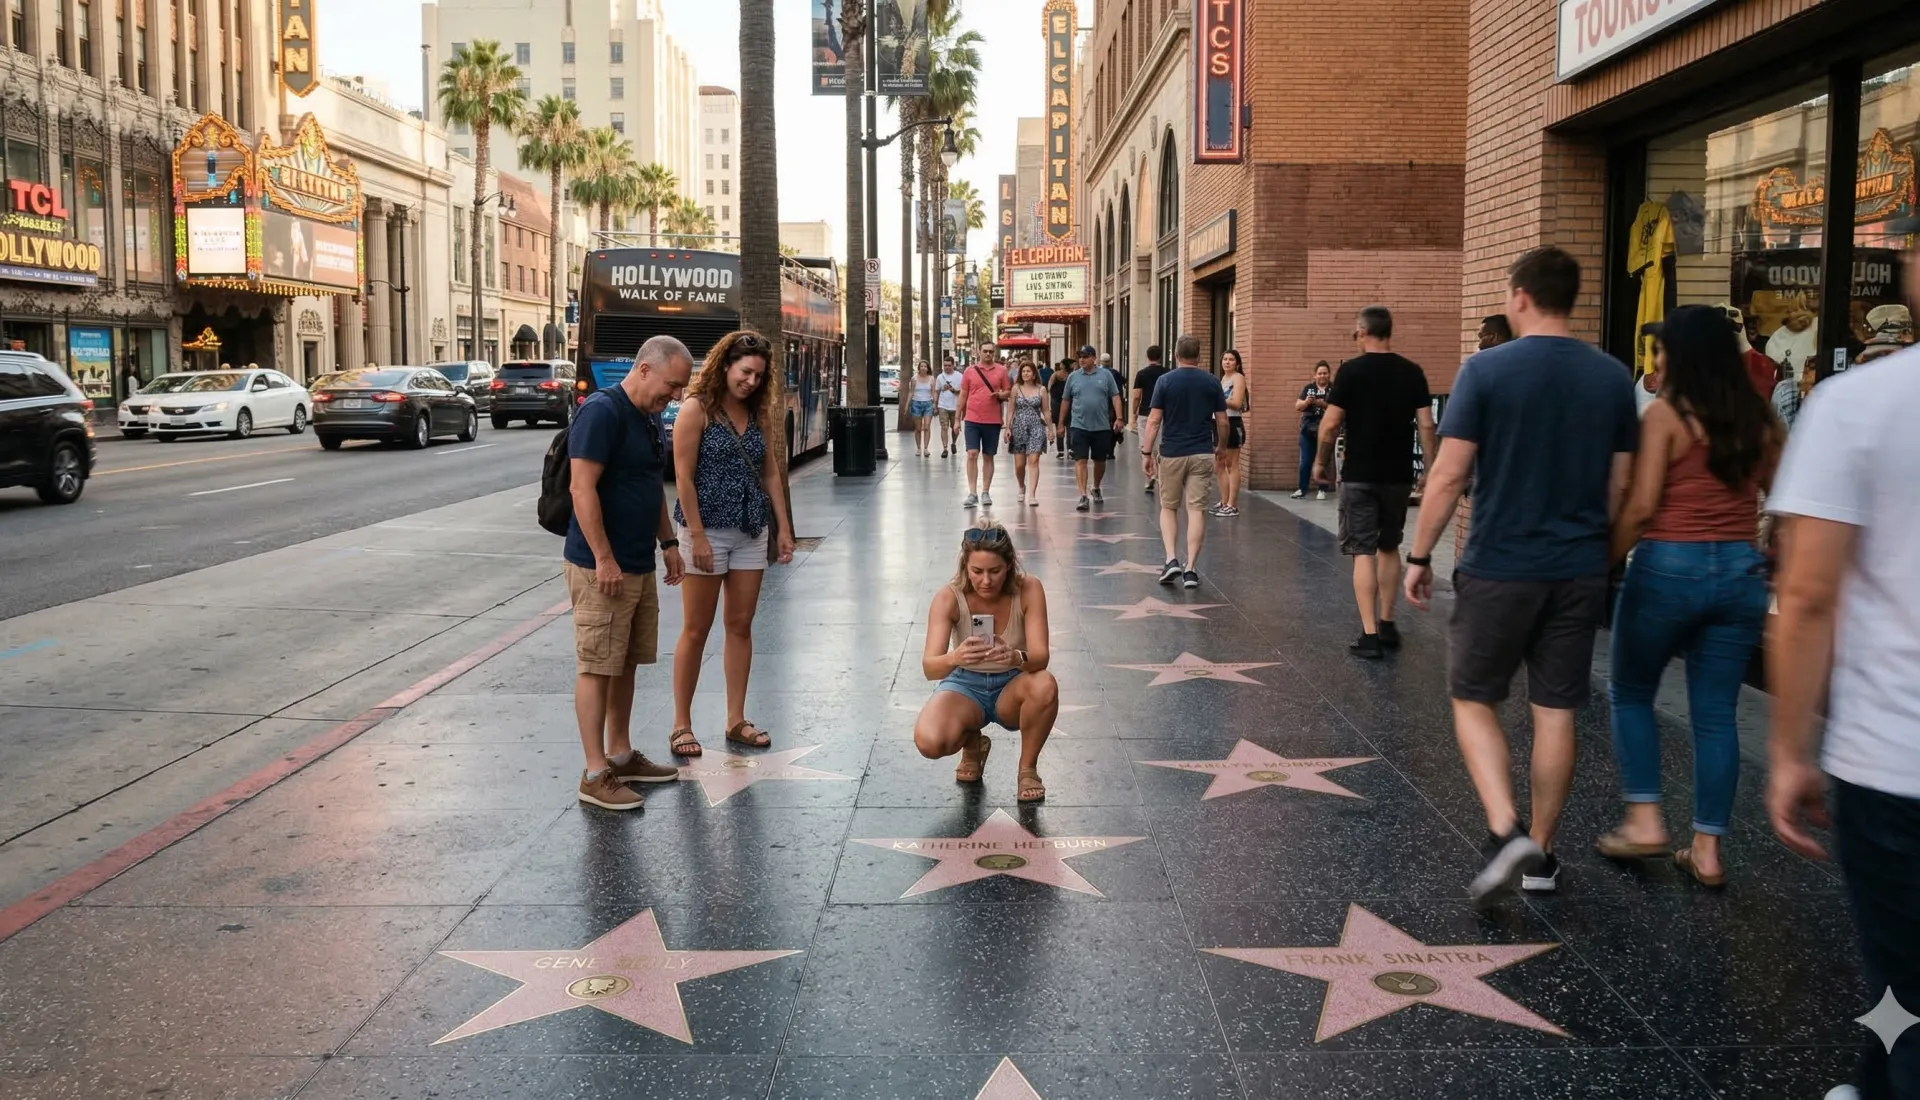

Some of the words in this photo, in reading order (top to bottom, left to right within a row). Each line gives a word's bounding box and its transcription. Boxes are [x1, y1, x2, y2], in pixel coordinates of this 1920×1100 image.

[1575, 0, 1673, 54] TOUR
[10, 179, 69, 219] TCL
[1011, 249, 1026, 264] EL
[1029, 246, 1084, 263] CAPITAN
[611, 265, 732, 288] HOLLYWOOD
[619, 289, 658, 300] WALK
[664, 290, 682, 300] OF
[688, 291, 726, 303] FAME
[892, 840, 1003, 850] KATHERINE
[1012, 839, 1108, 850] HEPBURN
[534, 957, 603, 969] GENE
[1284, 953, 1374, 966] FRANK
[1383, 952, 1494, 965] SINATRA
